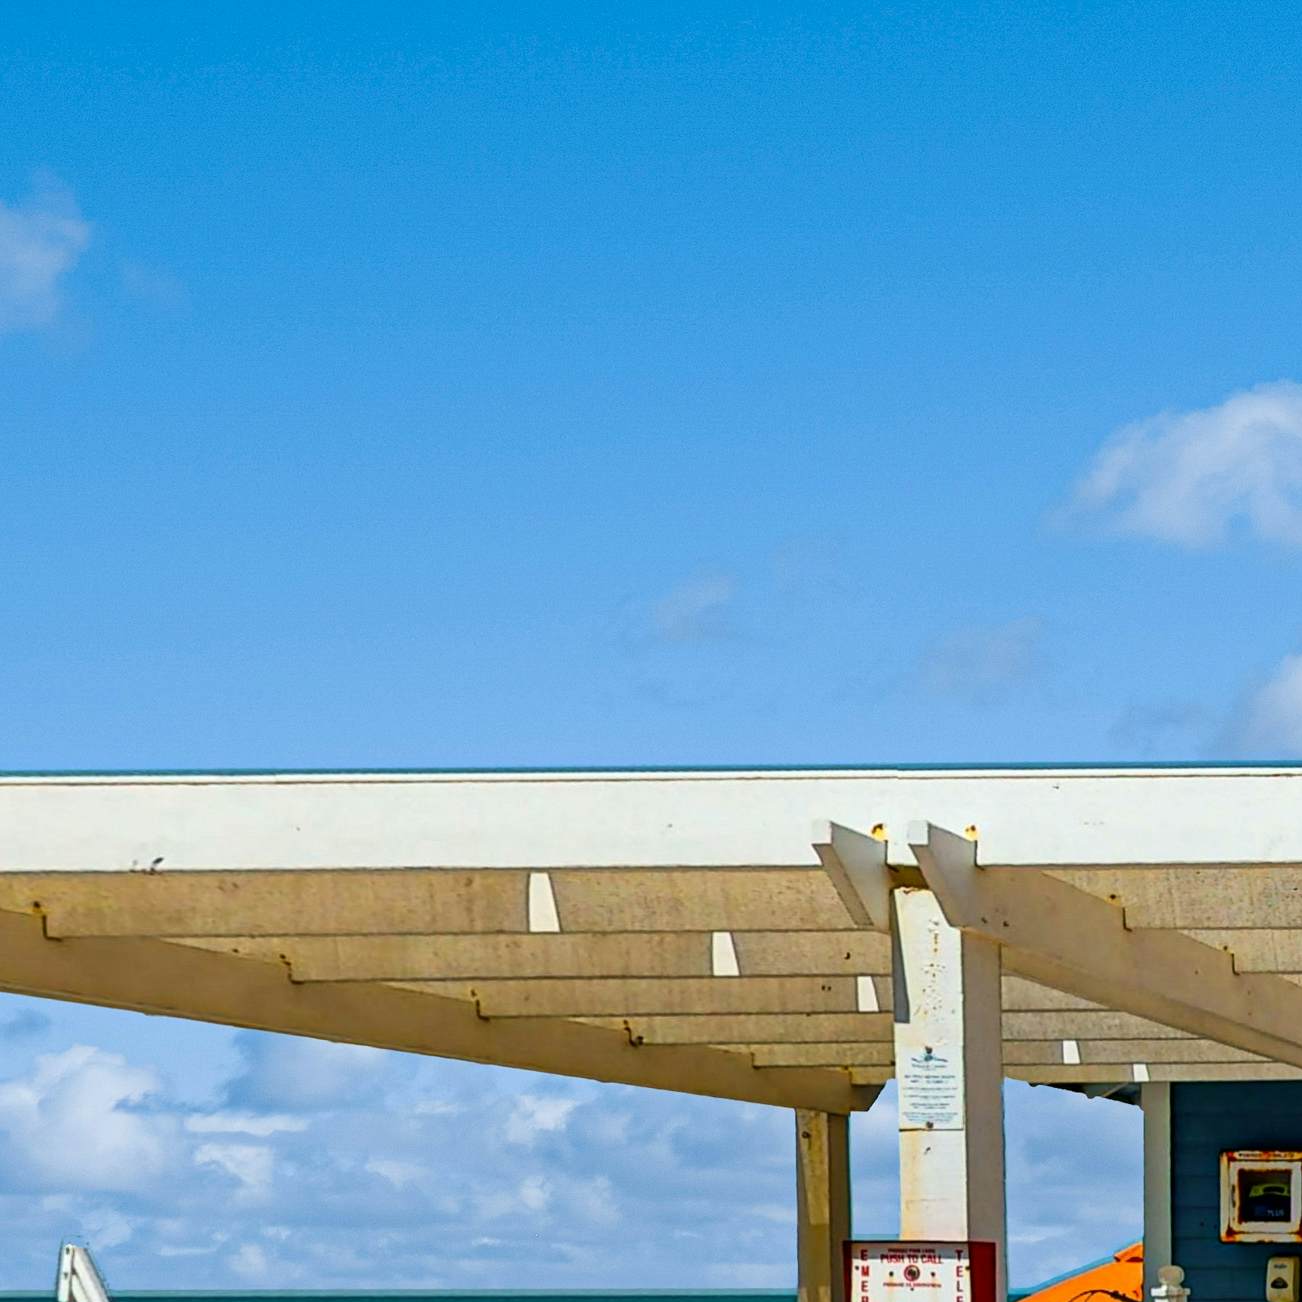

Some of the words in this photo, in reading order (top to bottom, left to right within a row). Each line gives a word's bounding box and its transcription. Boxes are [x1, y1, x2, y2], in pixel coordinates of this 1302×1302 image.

[880, 1253, 905, 1264] PUSH
[907, 1254, 918, 1264] TO
[920, 1254, 944, 1265] CALL
